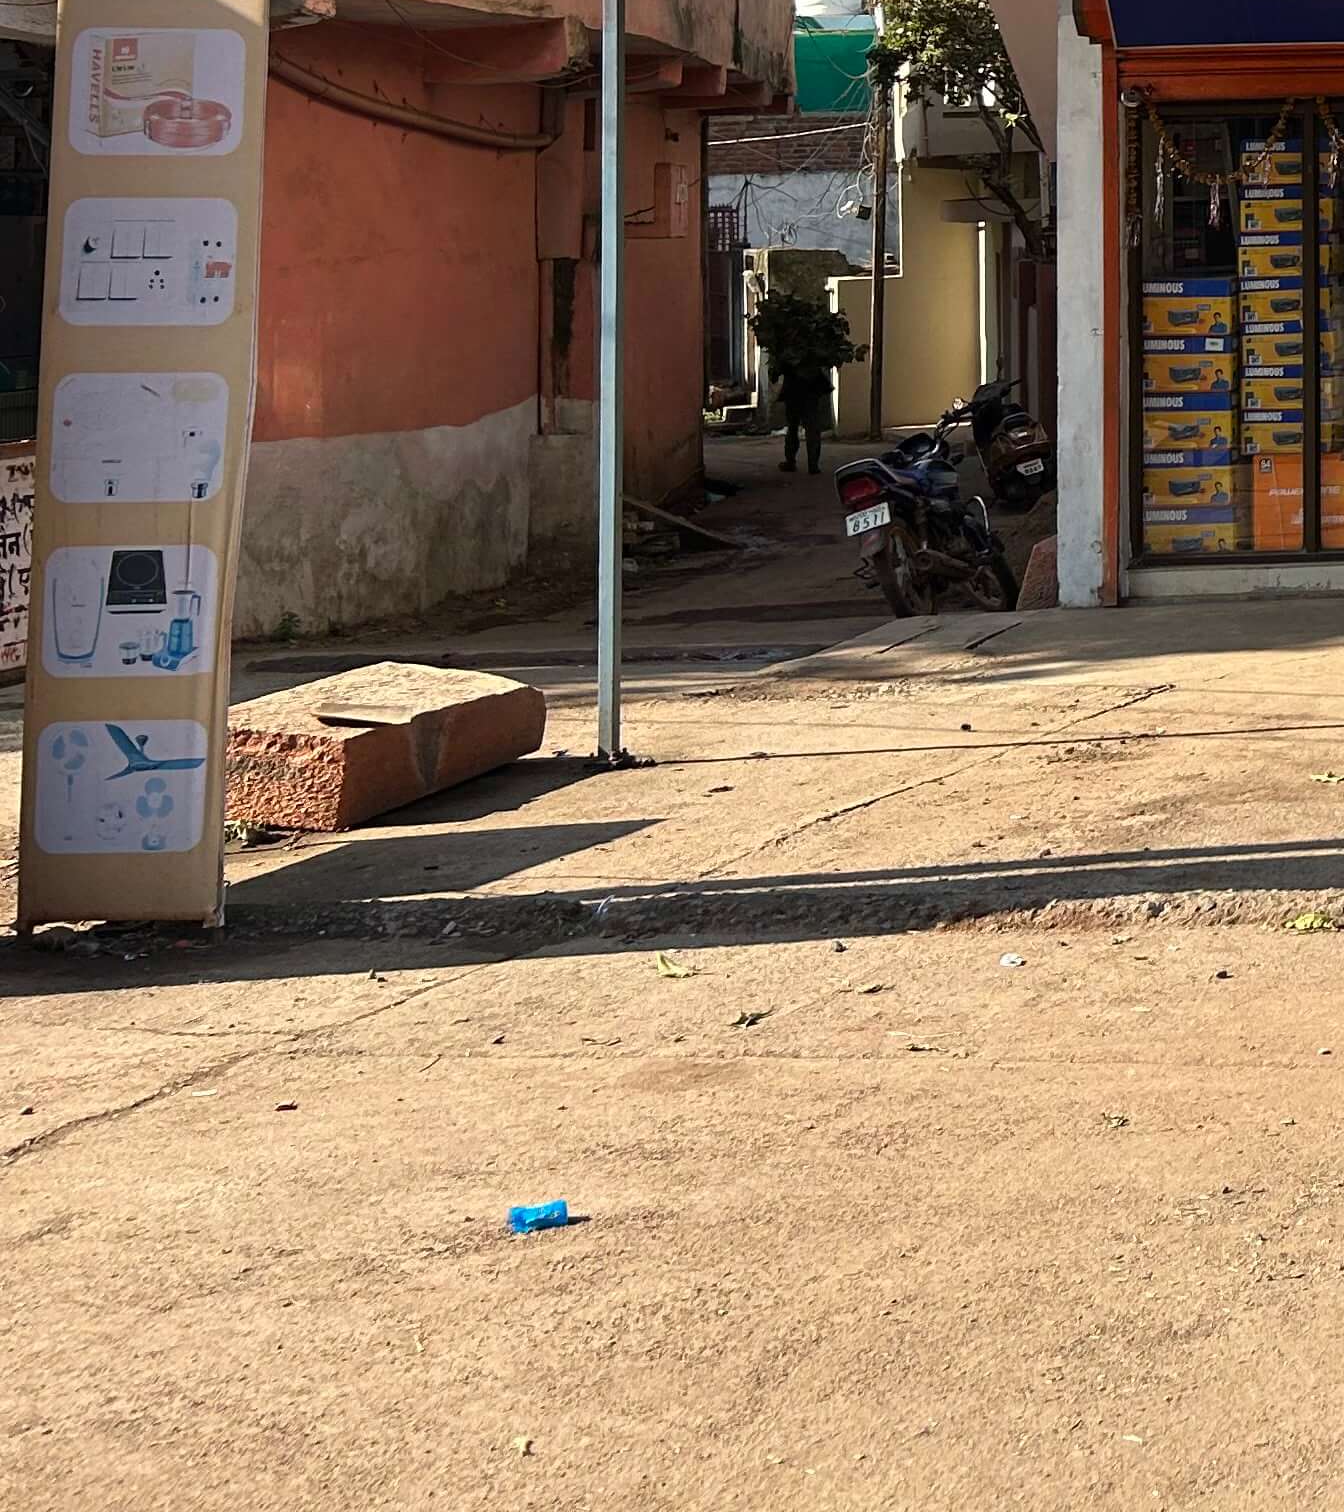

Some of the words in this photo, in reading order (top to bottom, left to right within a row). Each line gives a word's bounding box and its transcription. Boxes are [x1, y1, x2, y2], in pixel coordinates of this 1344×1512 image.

[88, 48, 103, 124] HAVELLS
[1142, 281, 1184, 295] UMINOUS
[1142, 338, 1186, 352] UMINOUS
[1142, 395, 1184, 408] UMINOUS
